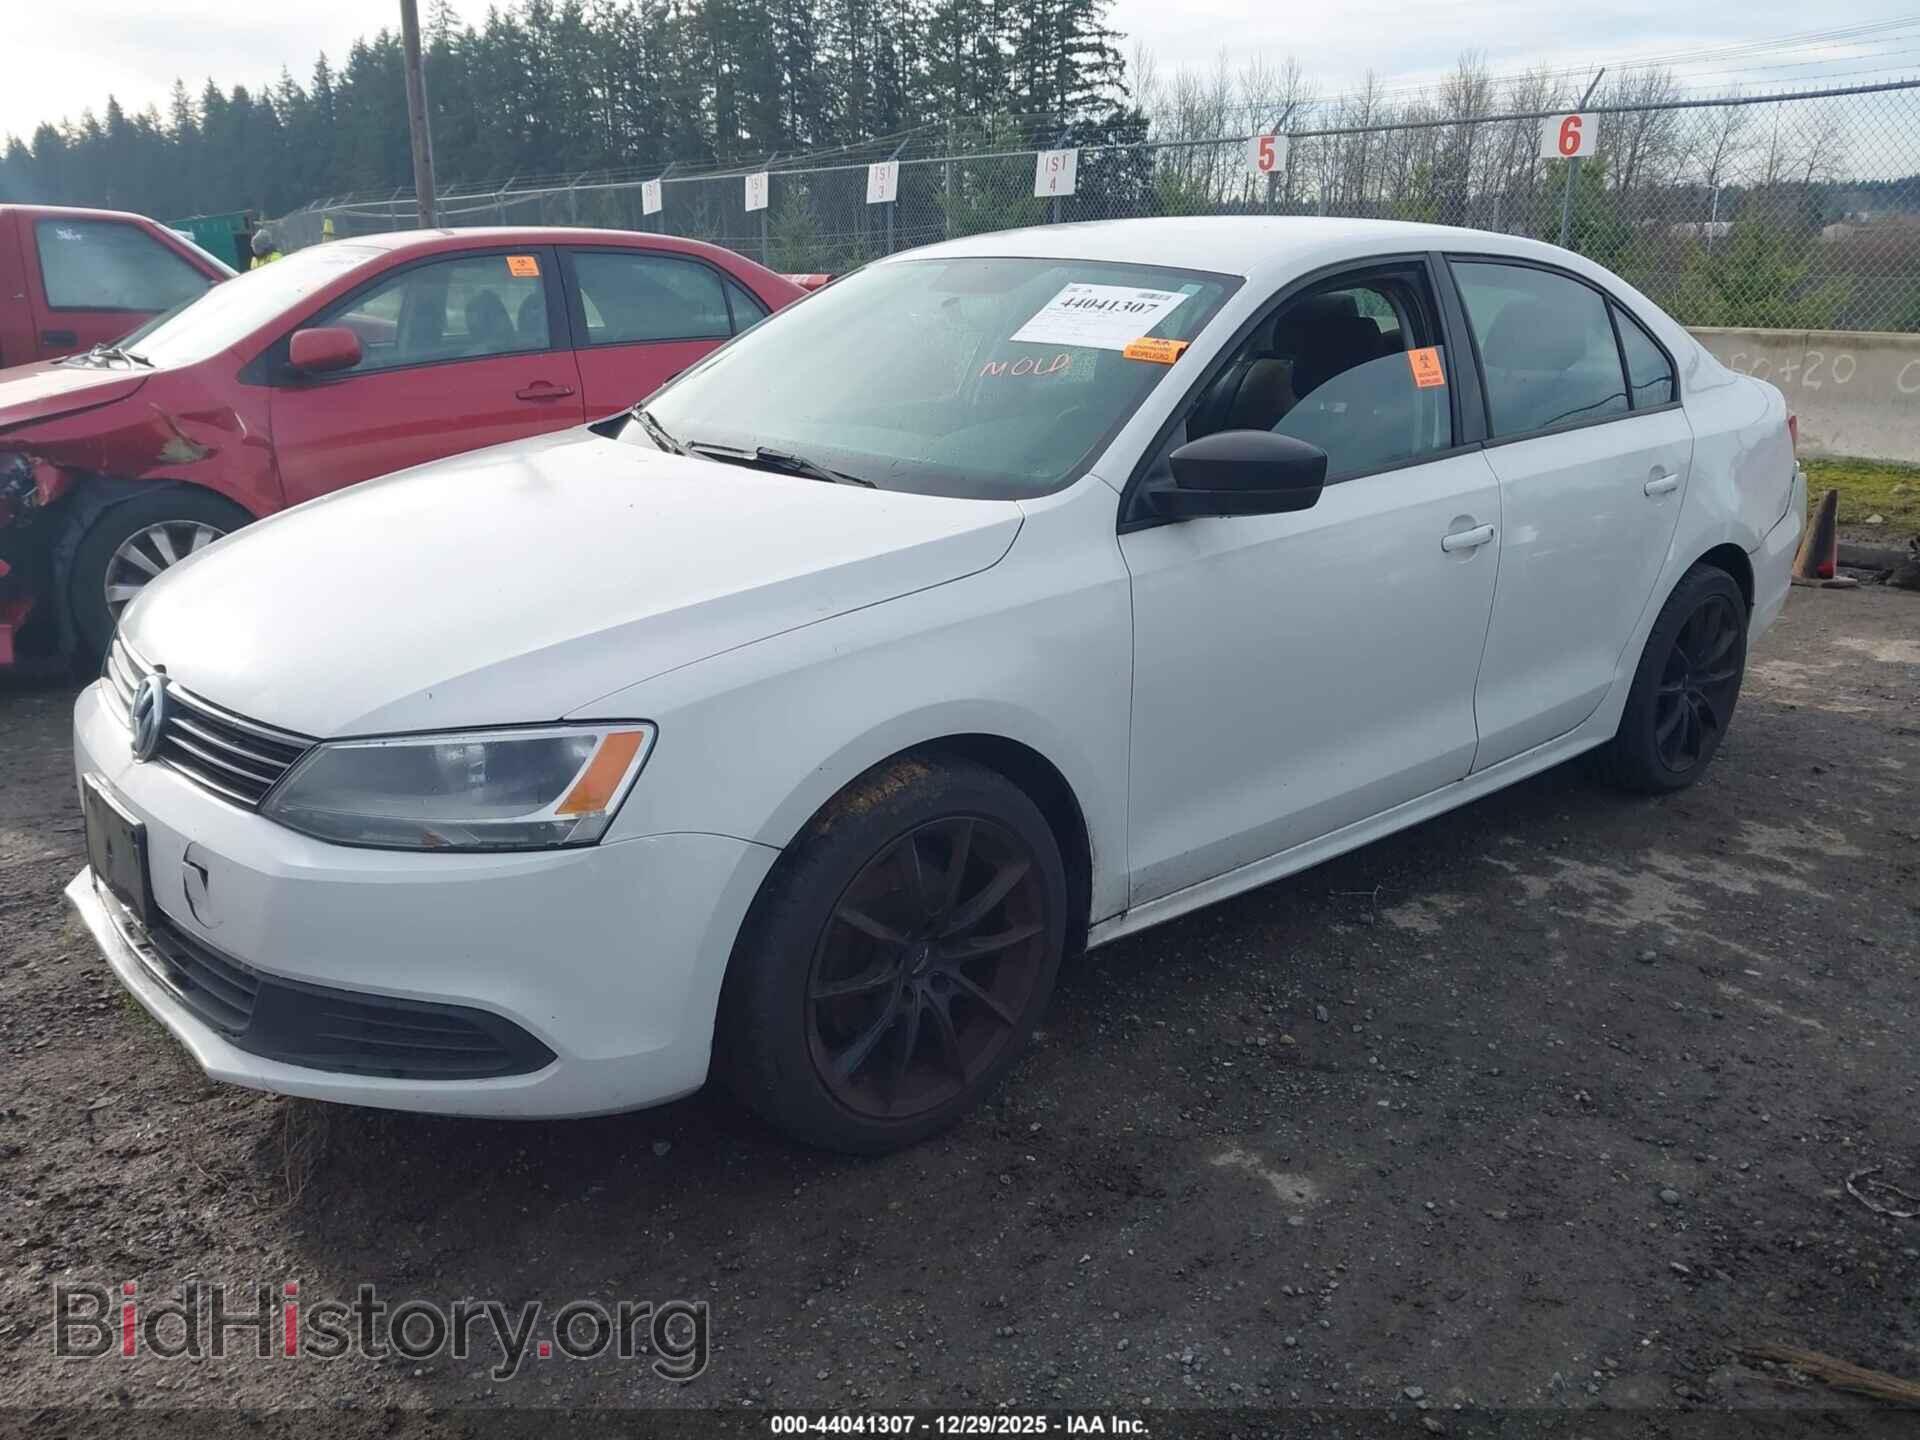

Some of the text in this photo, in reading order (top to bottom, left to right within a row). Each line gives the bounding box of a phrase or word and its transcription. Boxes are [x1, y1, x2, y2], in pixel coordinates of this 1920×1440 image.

[1557, 115, 1583, 156] 6
[1257, 136, 1276, 172] 5
[1060, 297, 1160, 314] 44041307
